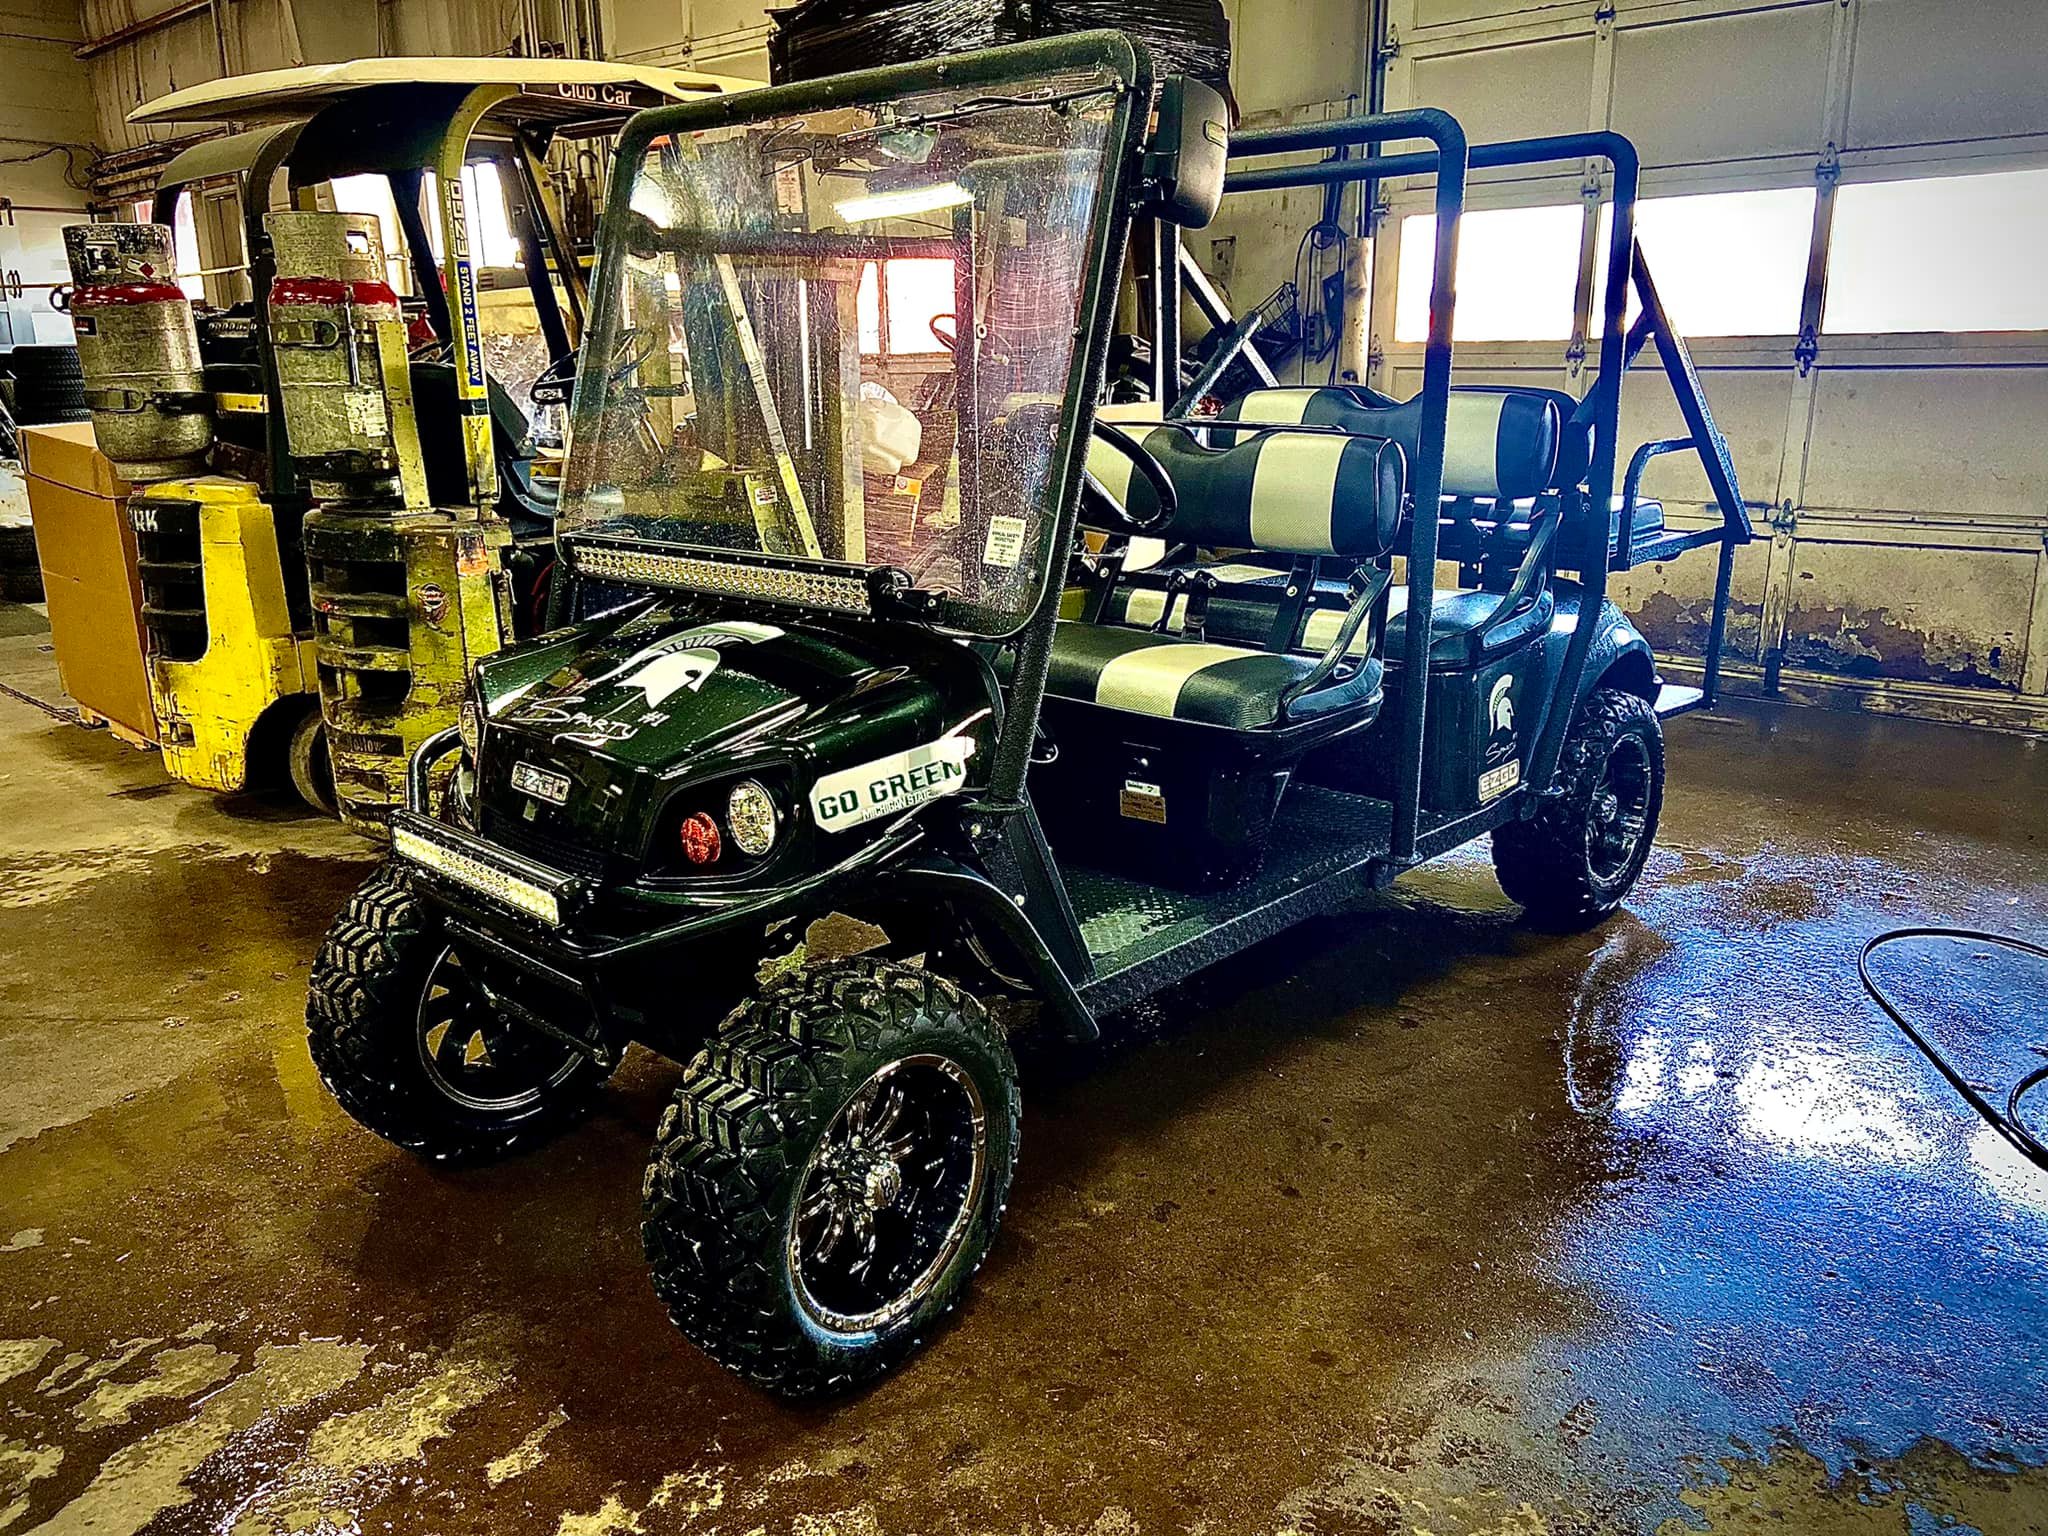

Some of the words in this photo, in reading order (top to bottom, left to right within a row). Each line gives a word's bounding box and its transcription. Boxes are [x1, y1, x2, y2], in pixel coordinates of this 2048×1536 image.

[558, 83, 597, 101] Club
[601, 84, 632, 105] Car
[460, 266, 473, 305] STAND
[464, 307, 474, 315] 2
[465, 317, 477, 346] FEET
[469, 348, 481, 380] AWAY
[513, 763, 570, 802] EZGO
[819, 790, 858, 820] GO
[870, 760, 962, 803] GREEN
[1481, 763, 1518, 792] EZGO
[862, 796, 906, 820] MICHIGAN
[907, 789, 932, 806] STATE
